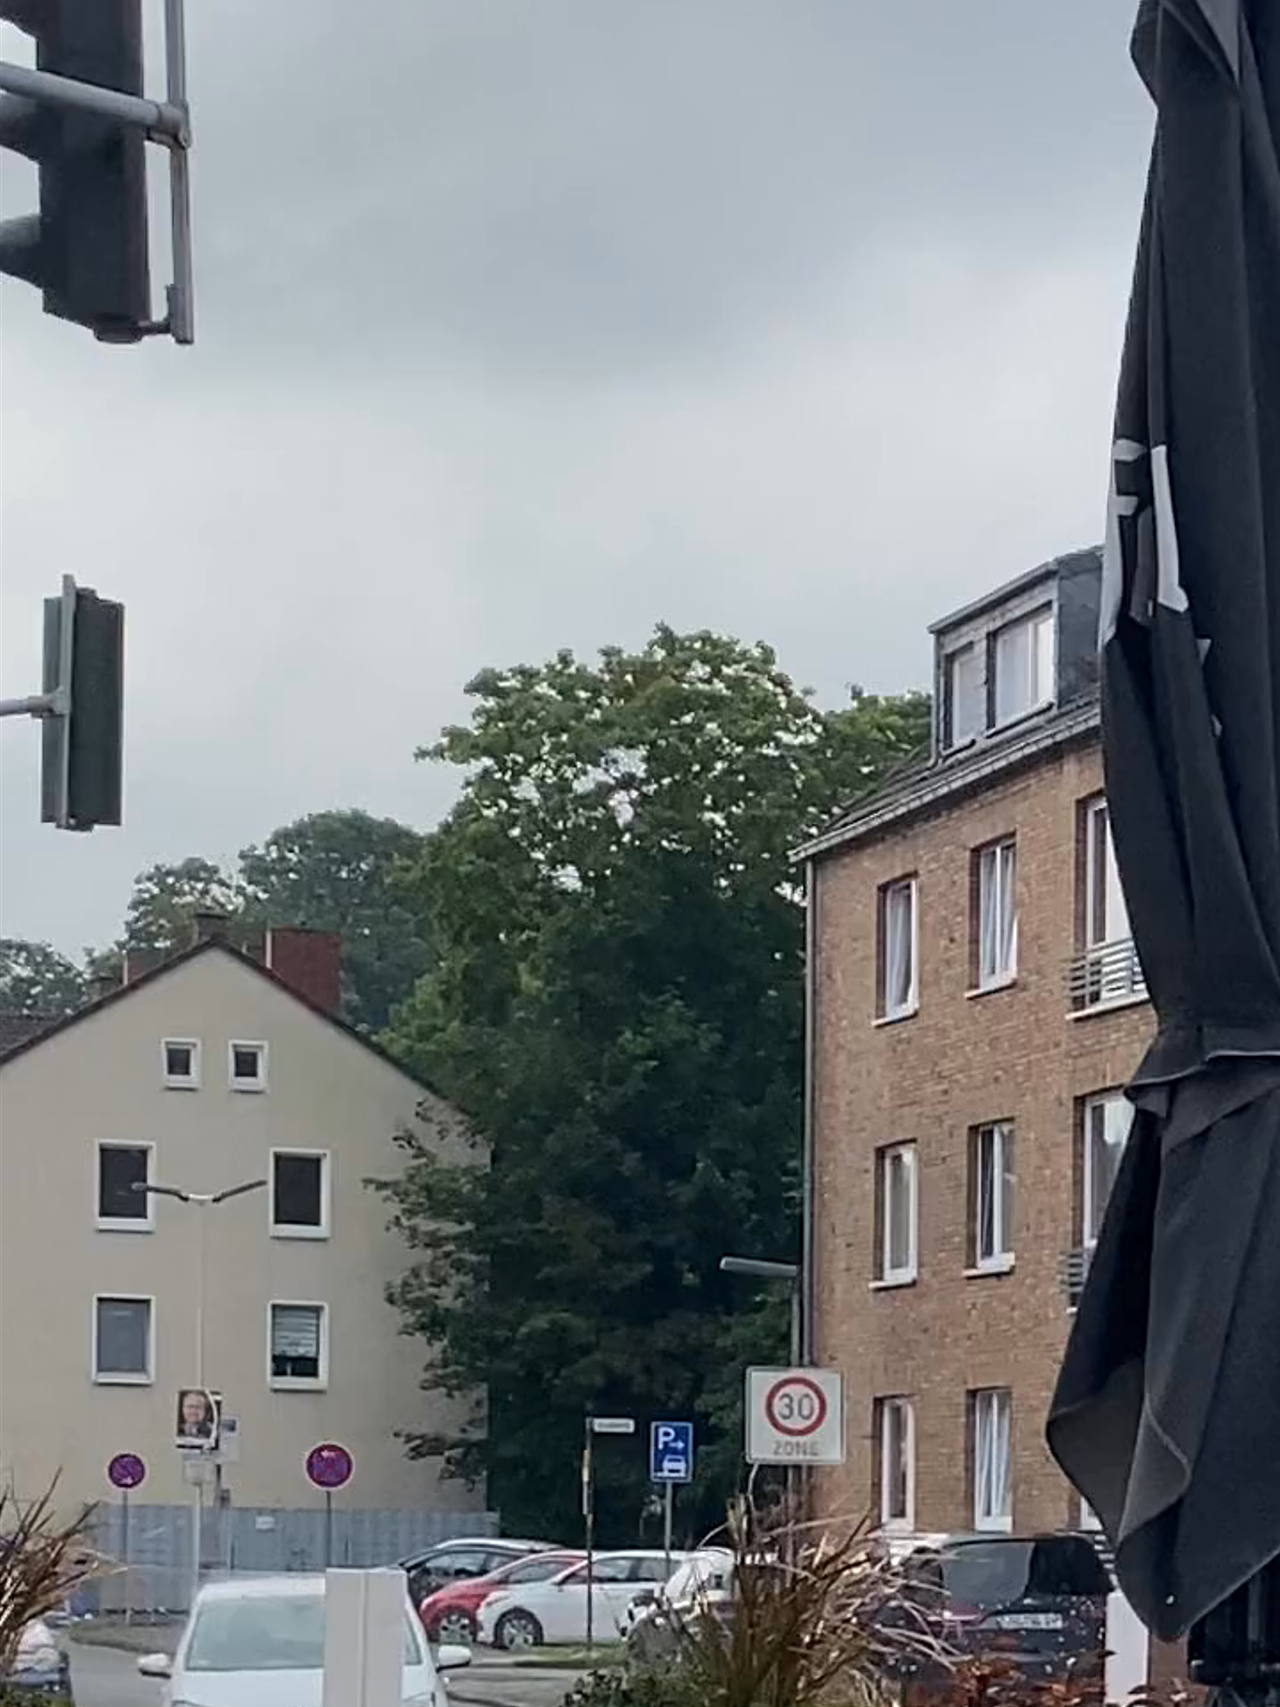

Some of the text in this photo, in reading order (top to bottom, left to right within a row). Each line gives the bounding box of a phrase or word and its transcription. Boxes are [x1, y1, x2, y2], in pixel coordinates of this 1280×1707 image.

[777, 1393, 815, 1421] 30
[657, 1426, 676, 1451] P
[773, 1439, 820, 1457] ZONE
